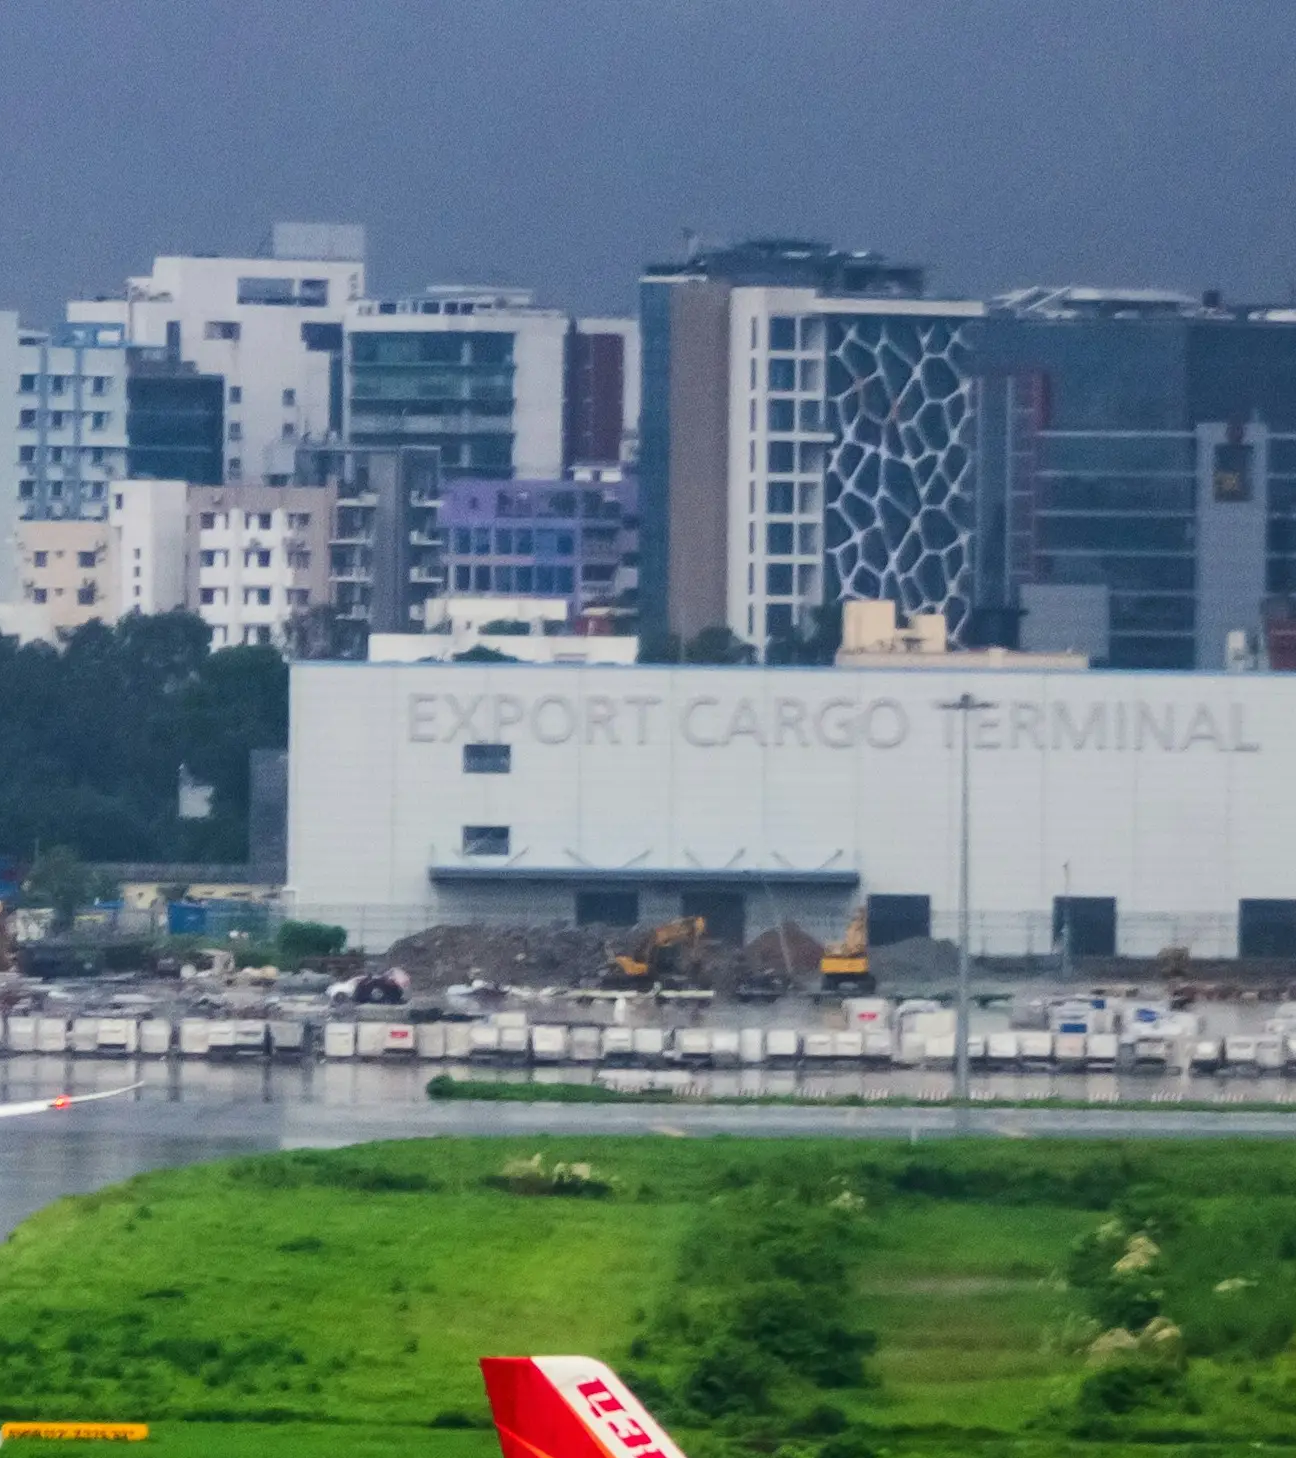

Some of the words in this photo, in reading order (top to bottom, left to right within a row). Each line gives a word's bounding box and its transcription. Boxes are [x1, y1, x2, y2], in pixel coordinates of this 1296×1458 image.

[406, 692, 662, 747] EXPORT
[680, 695, 909, 749] CARGO
[935, 698, 1260, 753] TERMINAL
